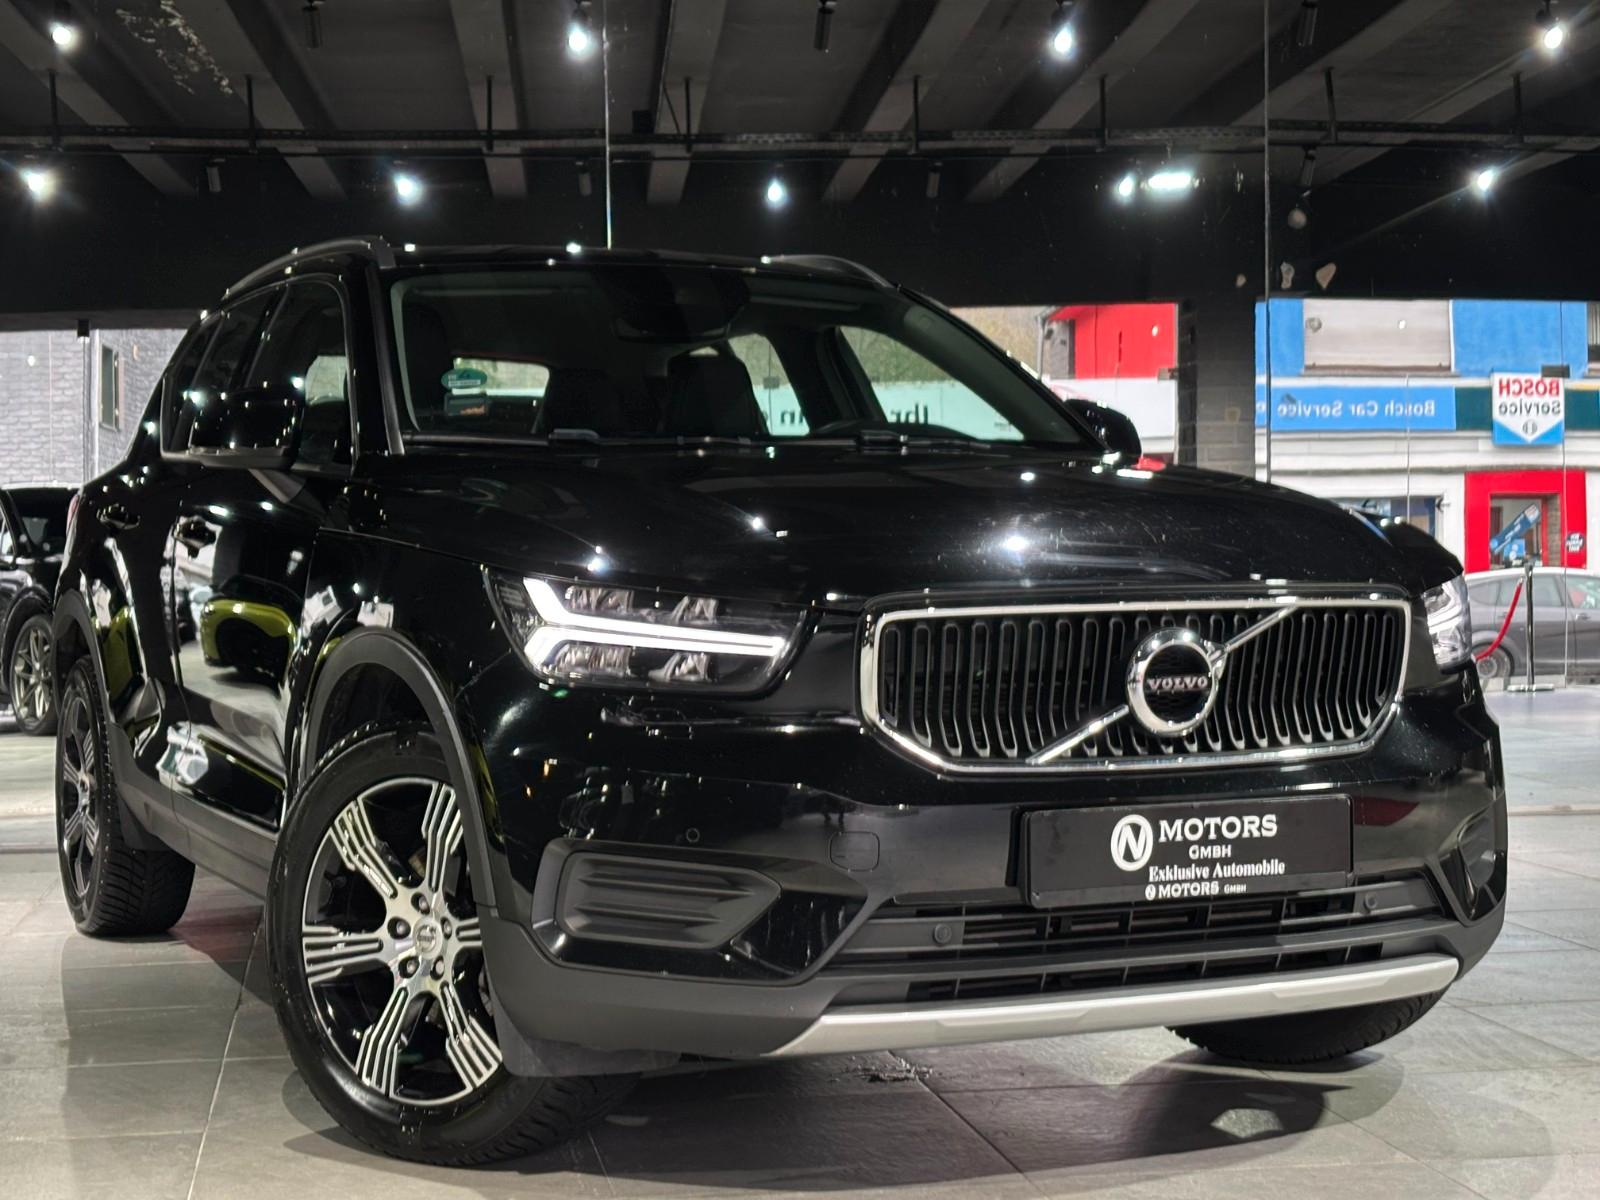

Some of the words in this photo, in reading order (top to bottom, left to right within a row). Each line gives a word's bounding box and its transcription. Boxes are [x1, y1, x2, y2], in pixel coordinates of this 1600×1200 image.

[1147, 675, 1208, 690] VOLVO
[1158, 813, 1278, 843] MOTORS
[1188, 845, 1232, 860] GMBH
[1149, 863, 1210, 883] Exklusive
[1212, 858, 1286, 879] Automobile
[1158, 881, 1220, 899] MOTORS
[1223, 883, 1248, 895] GMBH
